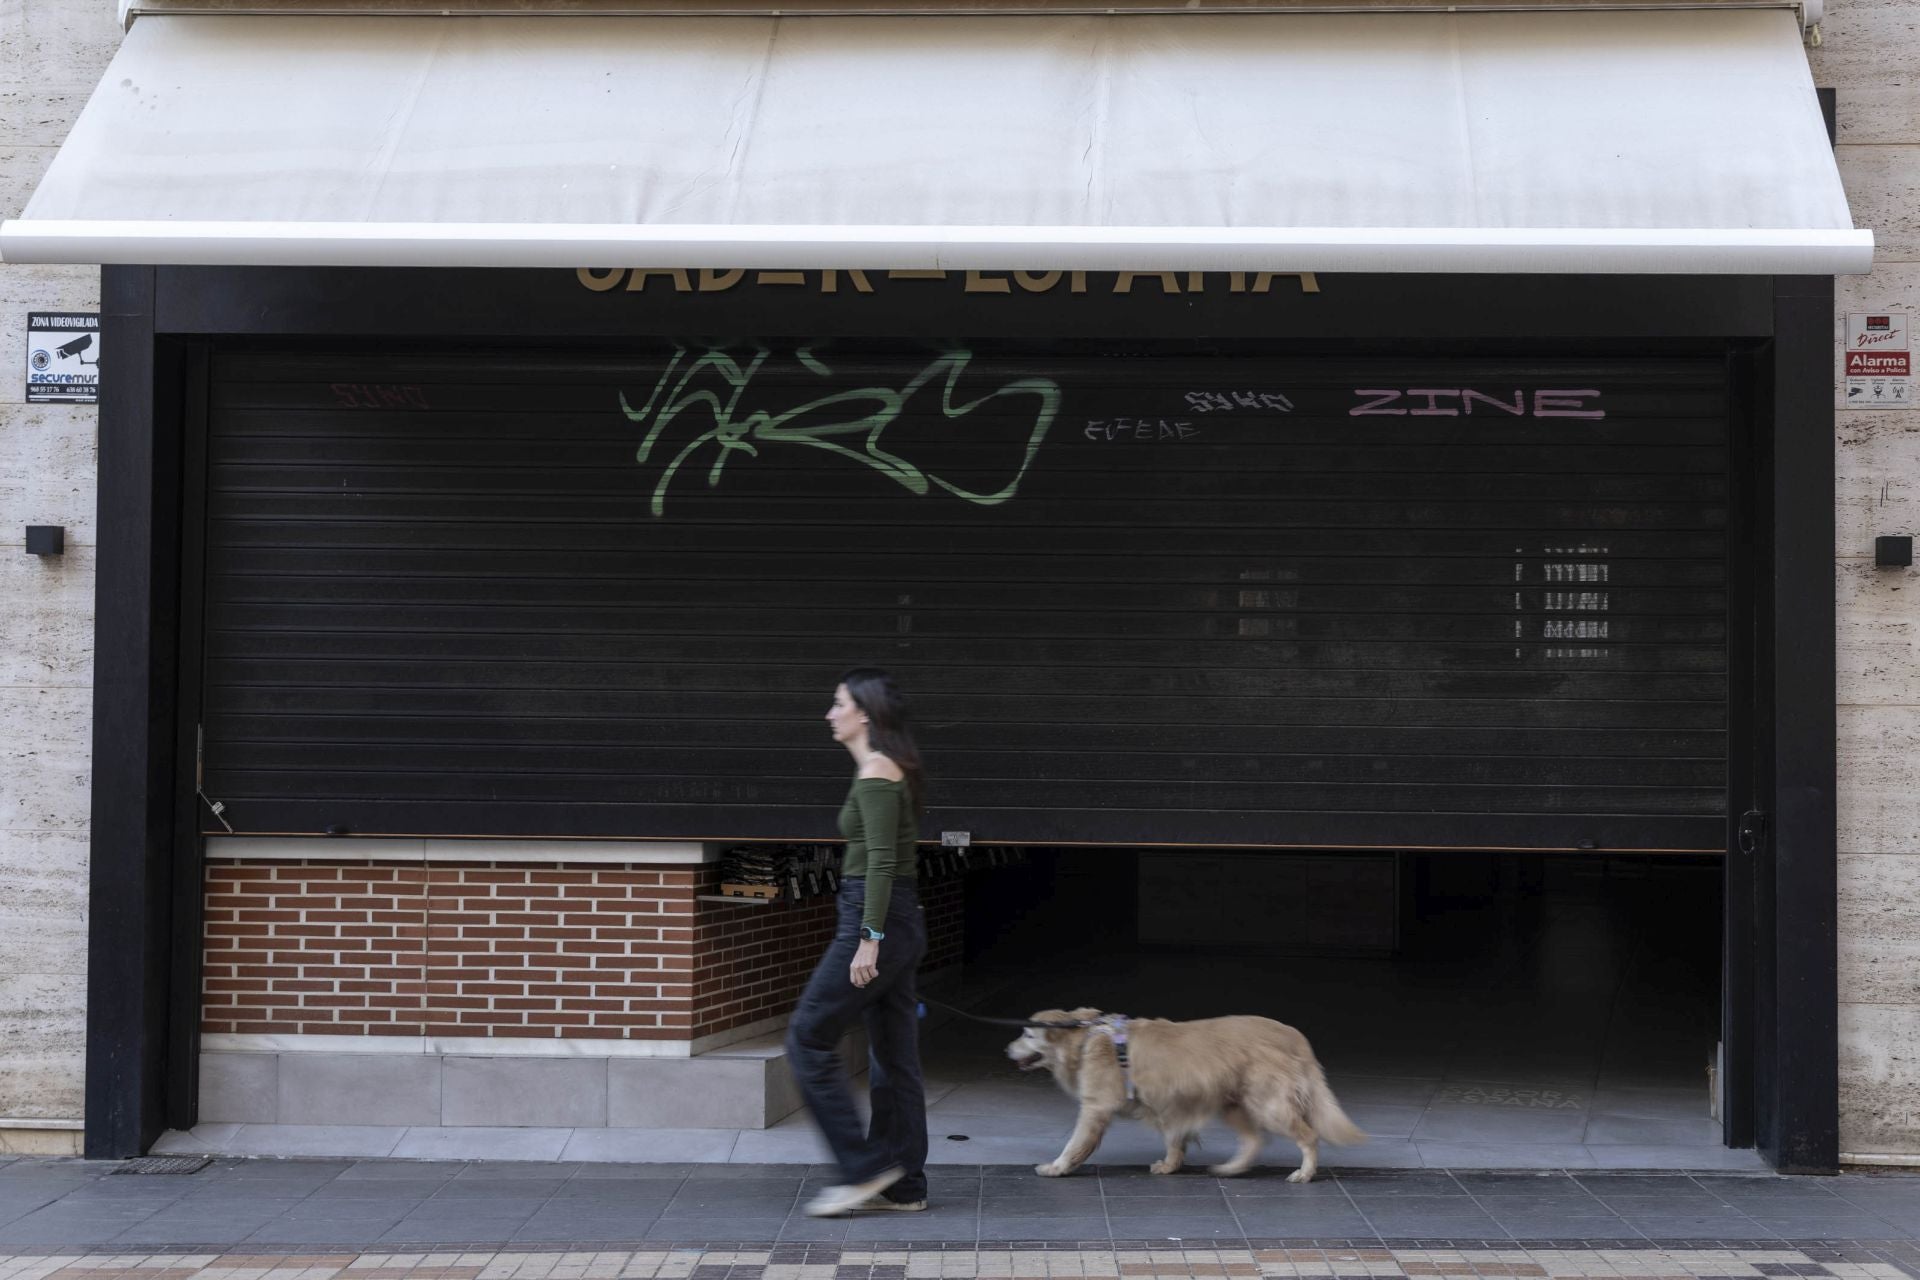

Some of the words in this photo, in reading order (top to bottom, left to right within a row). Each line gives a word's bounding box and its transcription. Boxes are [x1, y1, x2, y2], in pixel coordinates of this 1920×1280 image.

[31, 316, 49, 327] ZONA
[50, 317, 98, 328] VIDEOVIGILADA
[1850, 354, 1906, 366] Alarma
[31, 373, 97, 383] securemur
[1349, 389, 1606, 419] ZINE
